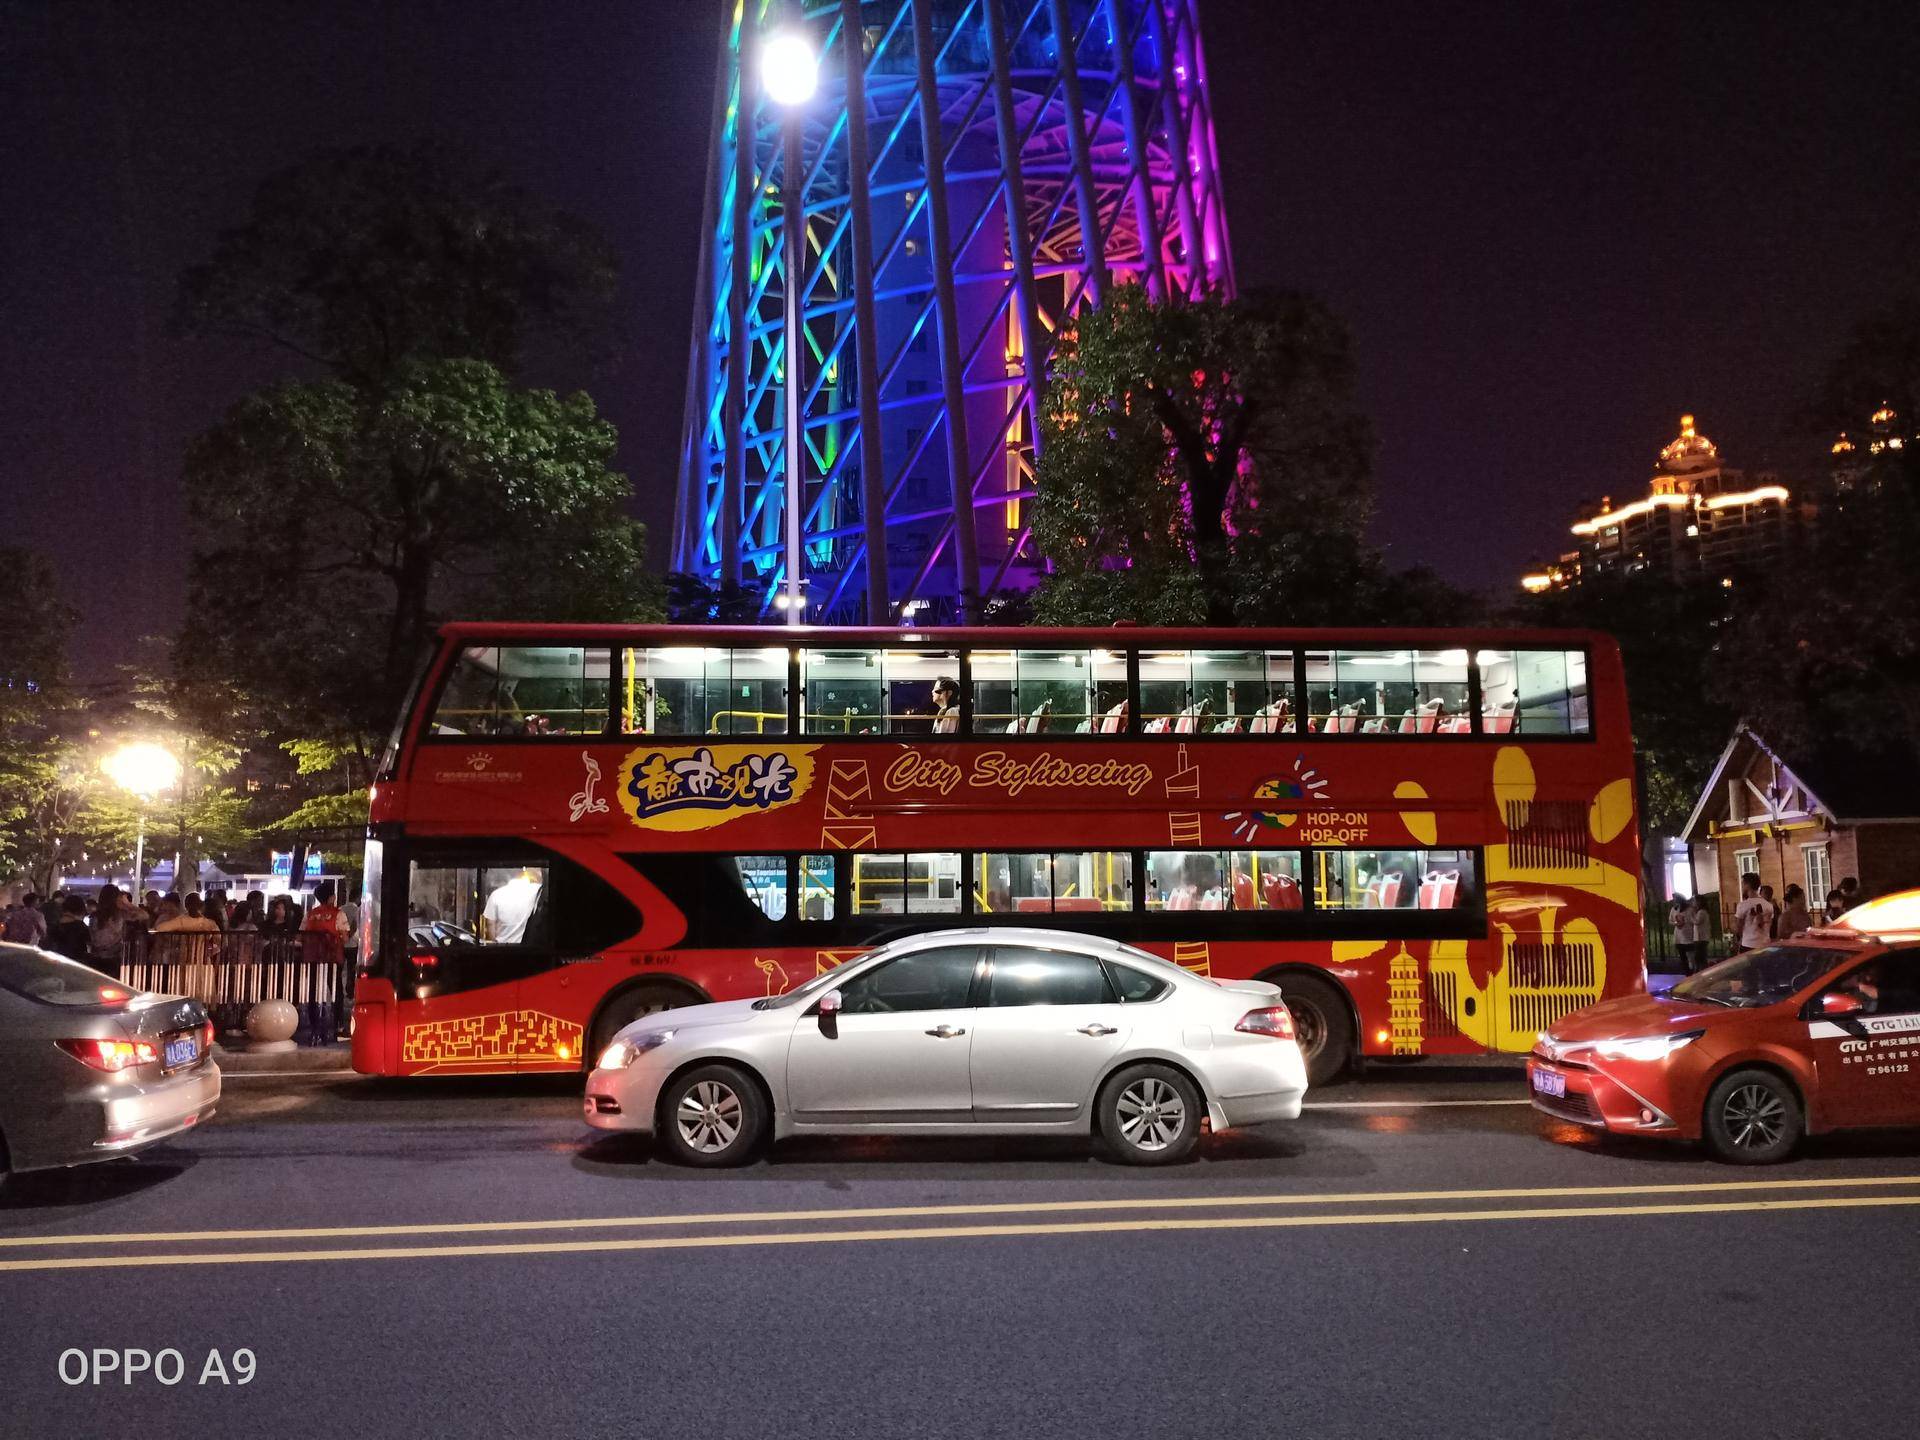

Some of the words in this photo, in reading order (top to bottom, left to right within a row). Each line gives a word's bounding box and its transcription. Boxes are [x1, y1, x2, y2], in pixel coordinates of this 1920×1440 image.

[636, 749, 797, 801] 都市观光
[884, 751, 962, 796] City
[968, 751, 1152, 796] Sightseeing
[1307, 812, 1368, 825] HOP-ON
[1300, 828, 1369, 842] HOP-OFF
[1871, 1020, 1895, 1030] GTG
[1840, 1040, 1868, 1053] GTG
[1877, 1064, 1909, 1074] 96122
